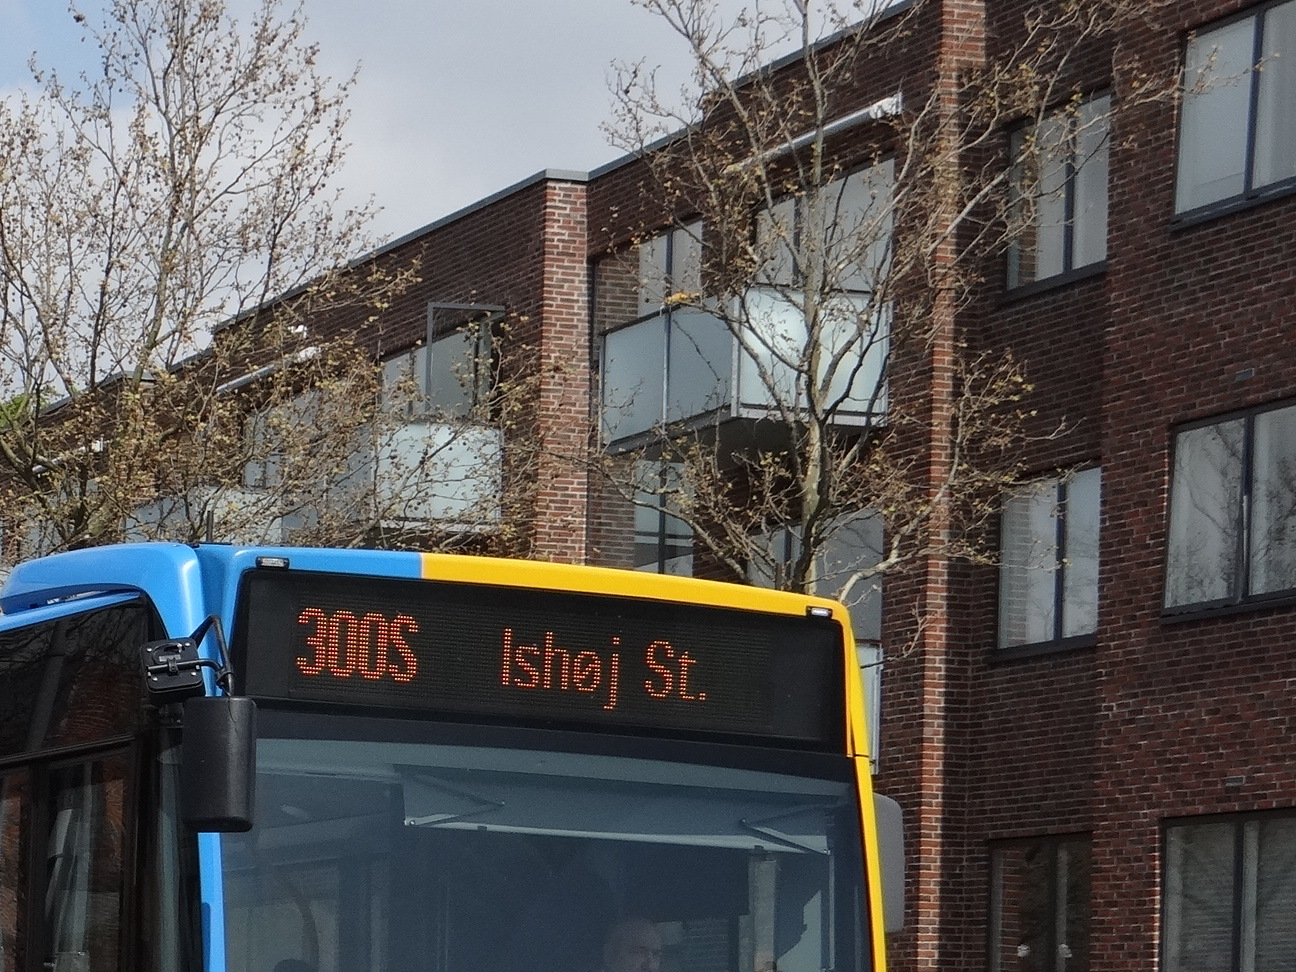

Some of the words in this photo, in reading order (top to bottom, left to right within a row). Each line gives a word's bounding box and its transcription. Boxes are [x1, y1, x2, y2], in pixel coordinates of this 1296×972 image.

[296, 606, 419, 685] 300S
[501, 627, 621, 711] Ishøj
[644, 639, 708, 704] St.
